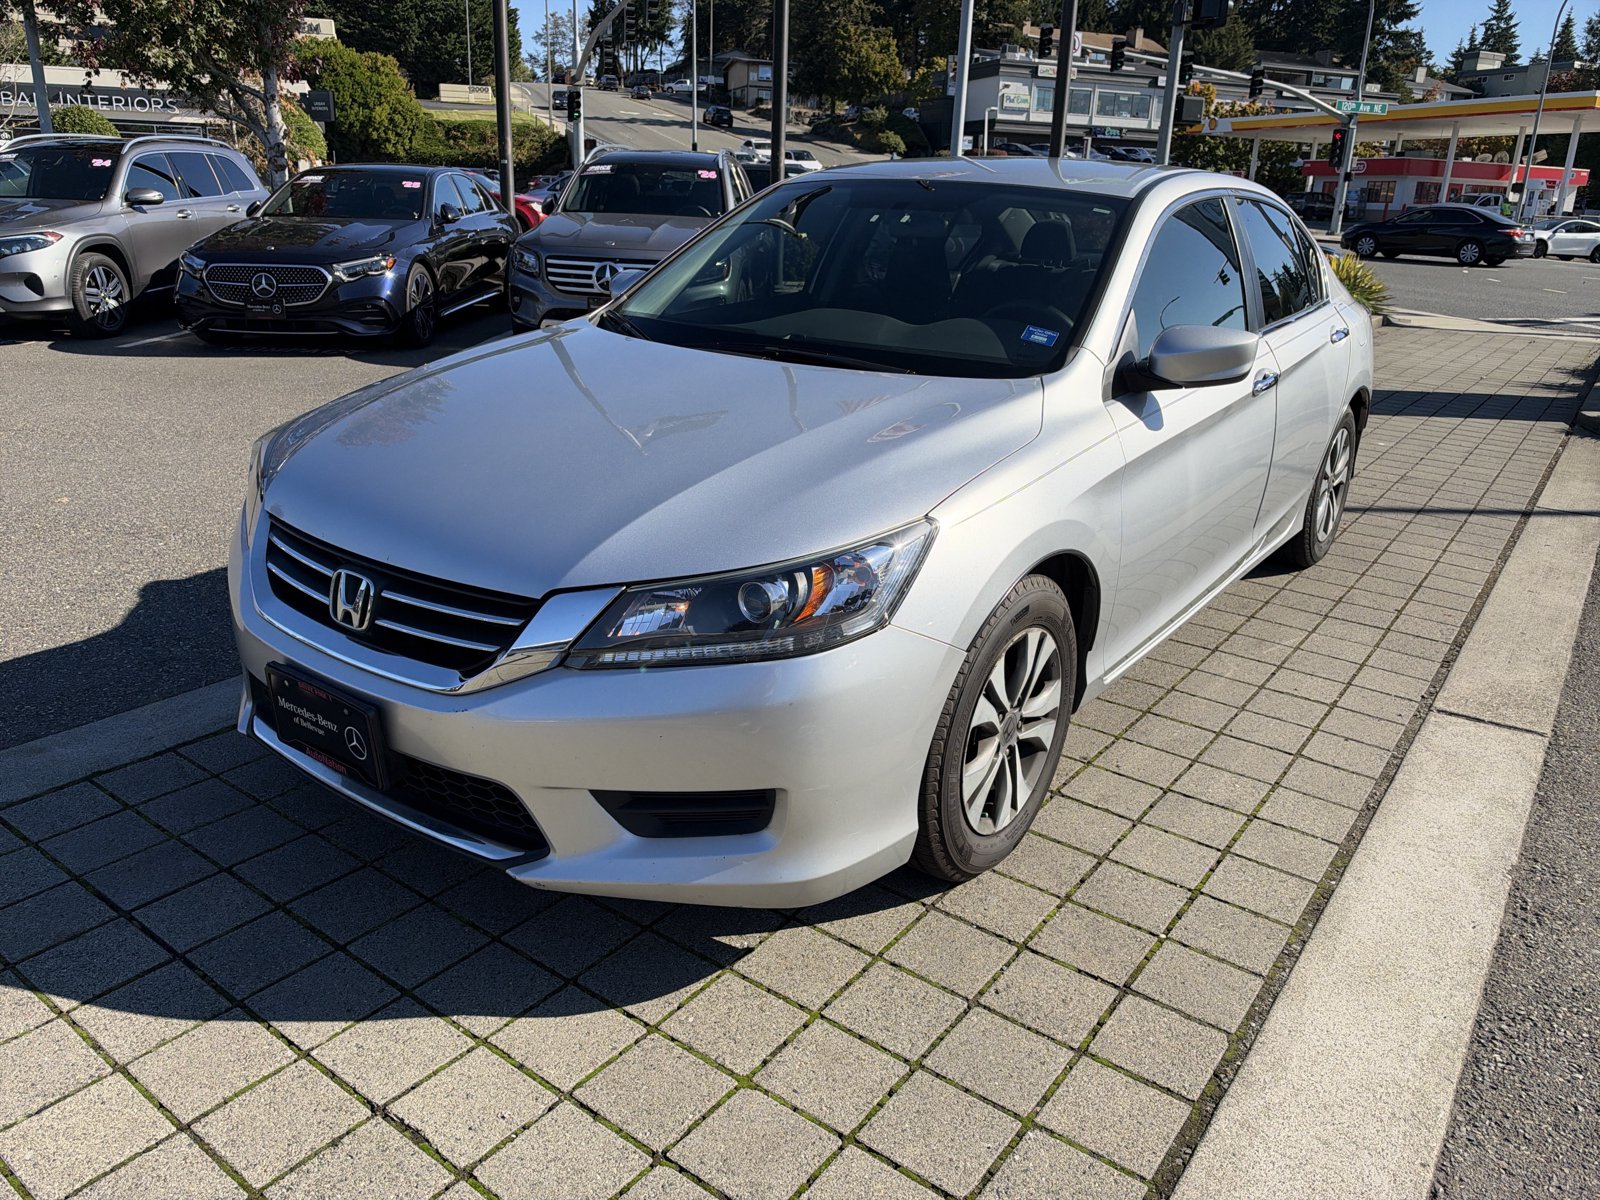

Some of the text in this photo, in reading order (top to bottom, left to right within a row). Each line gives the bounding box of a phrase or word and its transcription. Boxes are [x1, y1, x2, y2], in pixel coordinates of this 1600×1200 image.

[59, 91, 179, 114] INTERIORS
[1341, 101, 1383, 113] 120th Ave NE
[277, 695, 339, 733] Mercedes-Benz
[293, 716, 326, 736] of Bellevue
[305, 747, 347, 775] AutoNation
